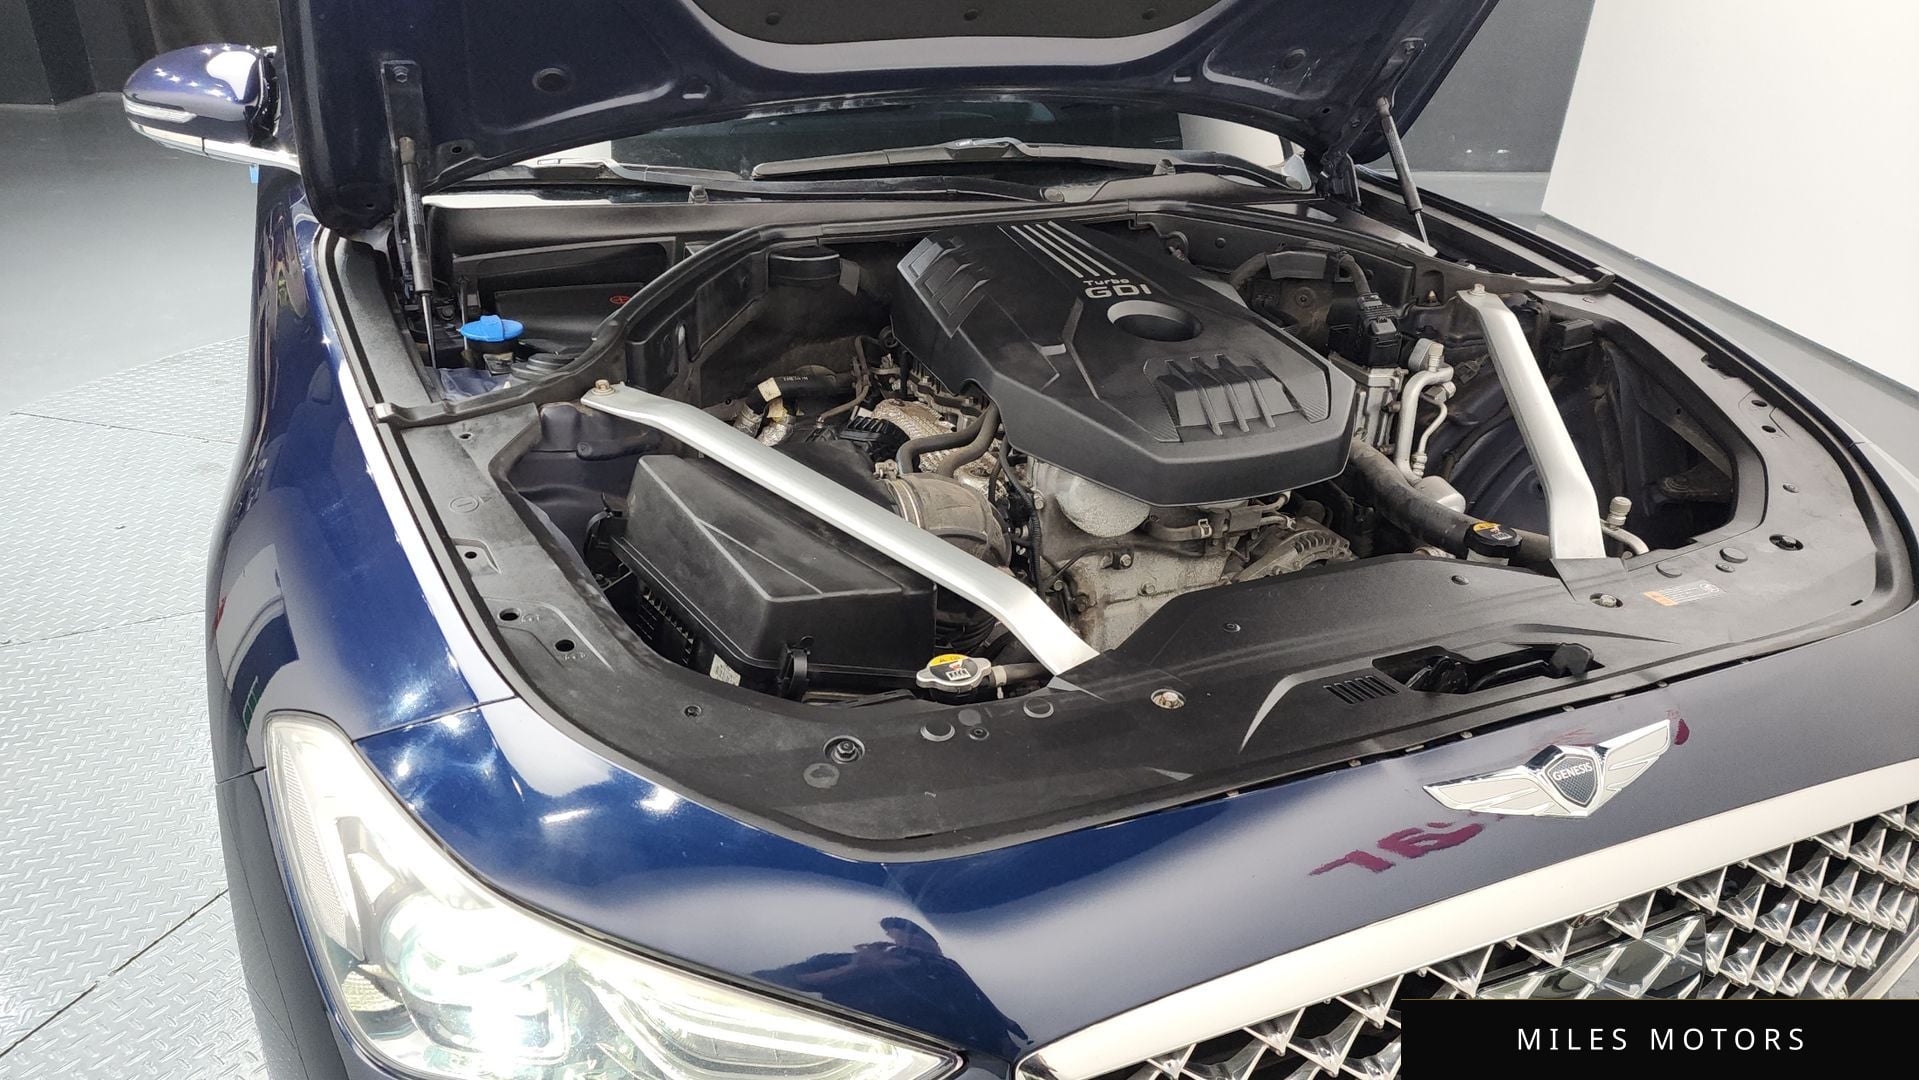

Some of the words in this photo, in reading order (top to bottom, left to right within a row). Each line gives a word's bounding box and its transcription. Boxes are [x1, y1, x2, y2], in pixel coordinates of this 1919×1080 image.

[1083, 278, 1130, 286] Turbo
[1084, 283, 1152, 299] GDI
[1552, 762, 1593, 781] GENESIS
